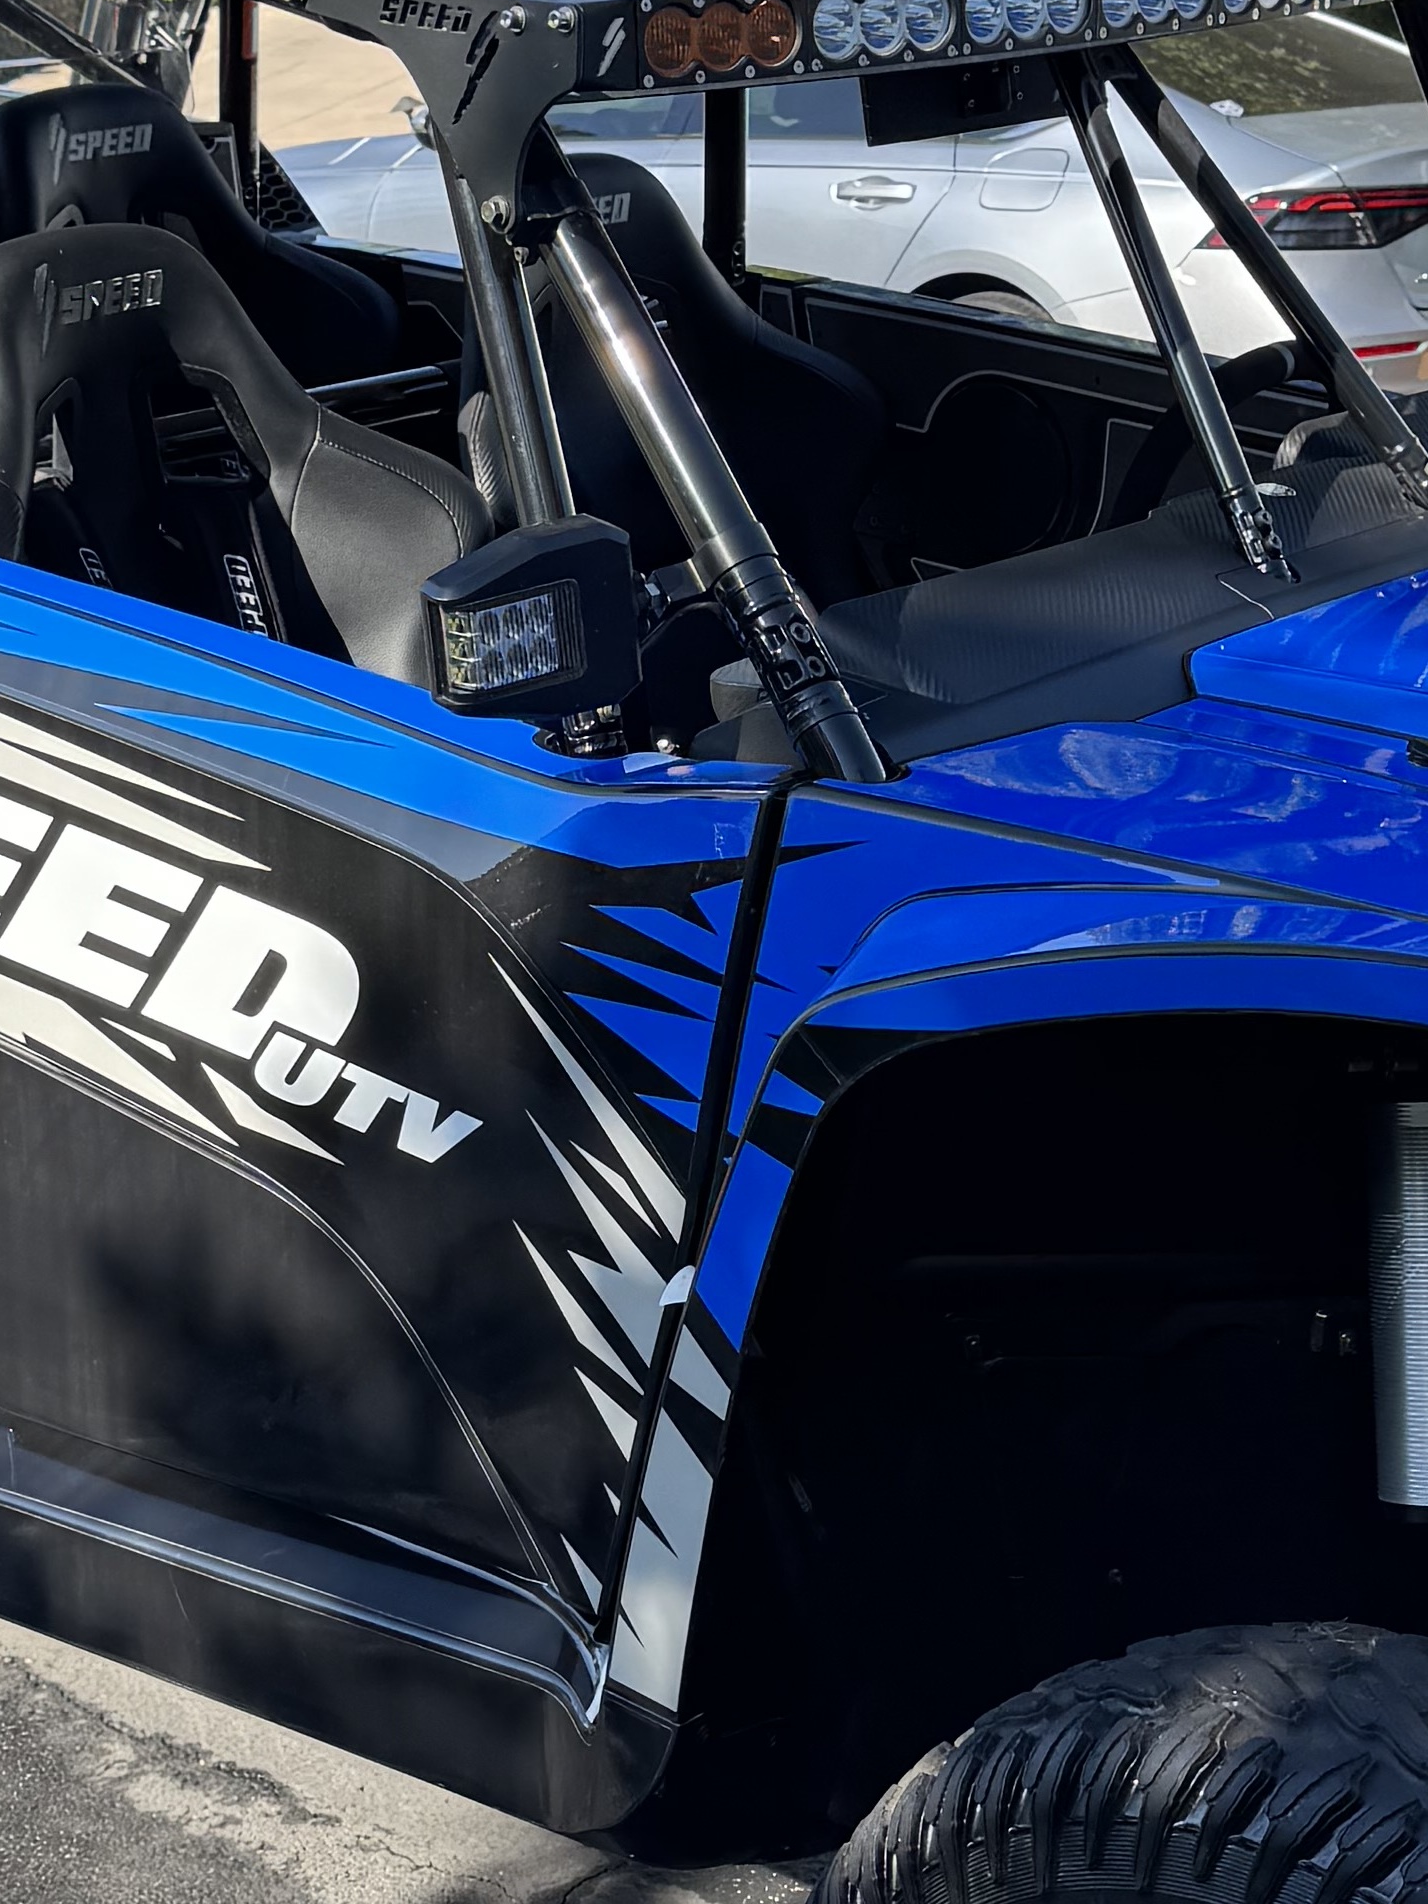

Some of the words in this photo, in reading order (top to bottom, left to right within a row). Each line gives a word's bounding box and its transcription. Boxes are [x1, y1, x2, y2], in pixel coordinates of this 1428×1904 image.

[68, 123, 153, 162] SPEED
[59, 269, 163, 325] SPEED
[223, 554, 268, 637] PEED
[253, 1029, 484, 1164] UTV
